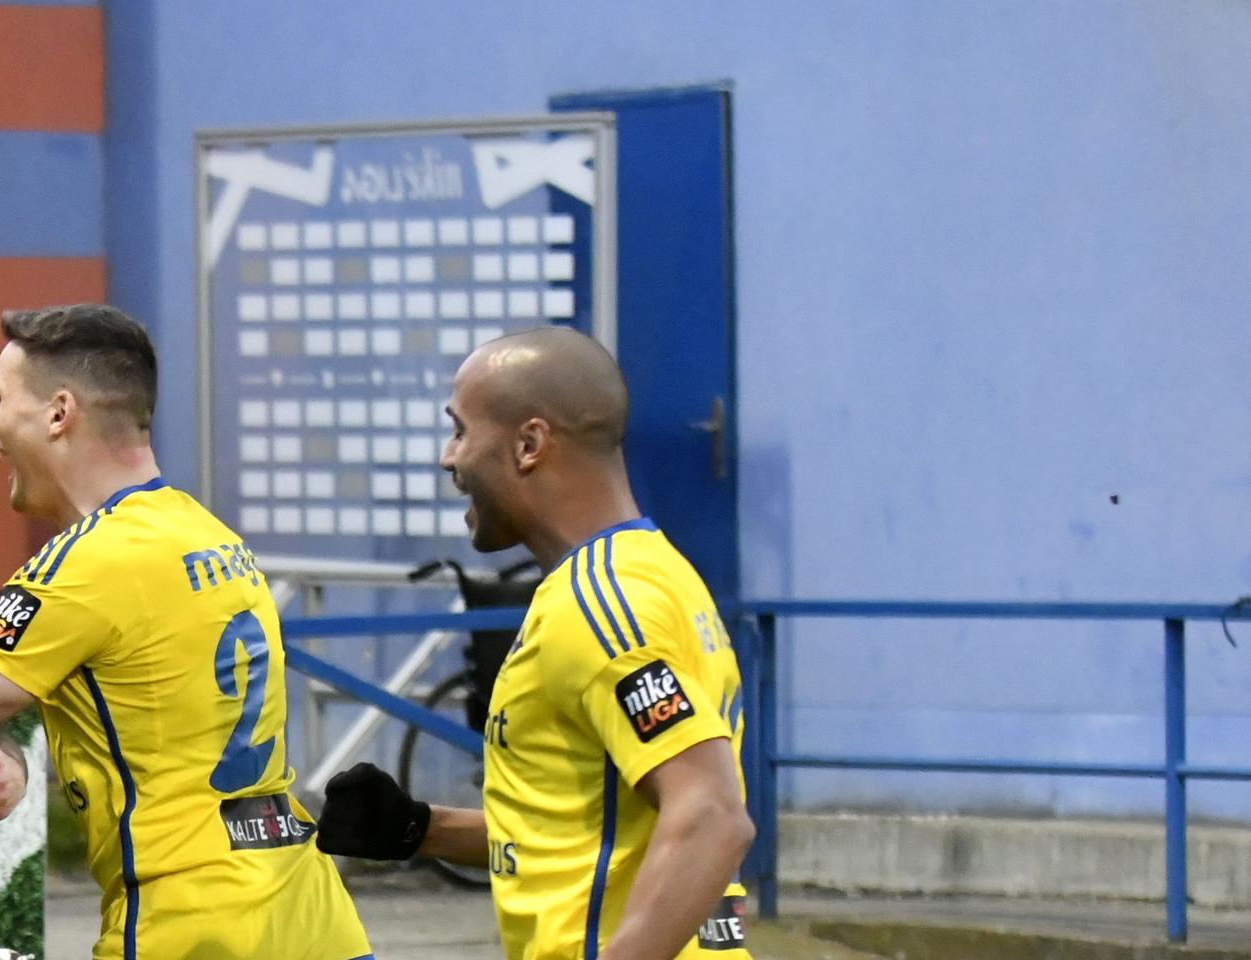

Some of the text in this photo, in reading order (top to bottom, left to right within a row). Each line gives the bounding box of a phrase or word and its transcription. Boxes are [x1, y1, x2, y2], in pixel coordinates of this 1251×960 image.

[209, 609, 276, 794] 2
[624, 667, 678, 717] niké
[636, 694, 683, 734] LIGA
